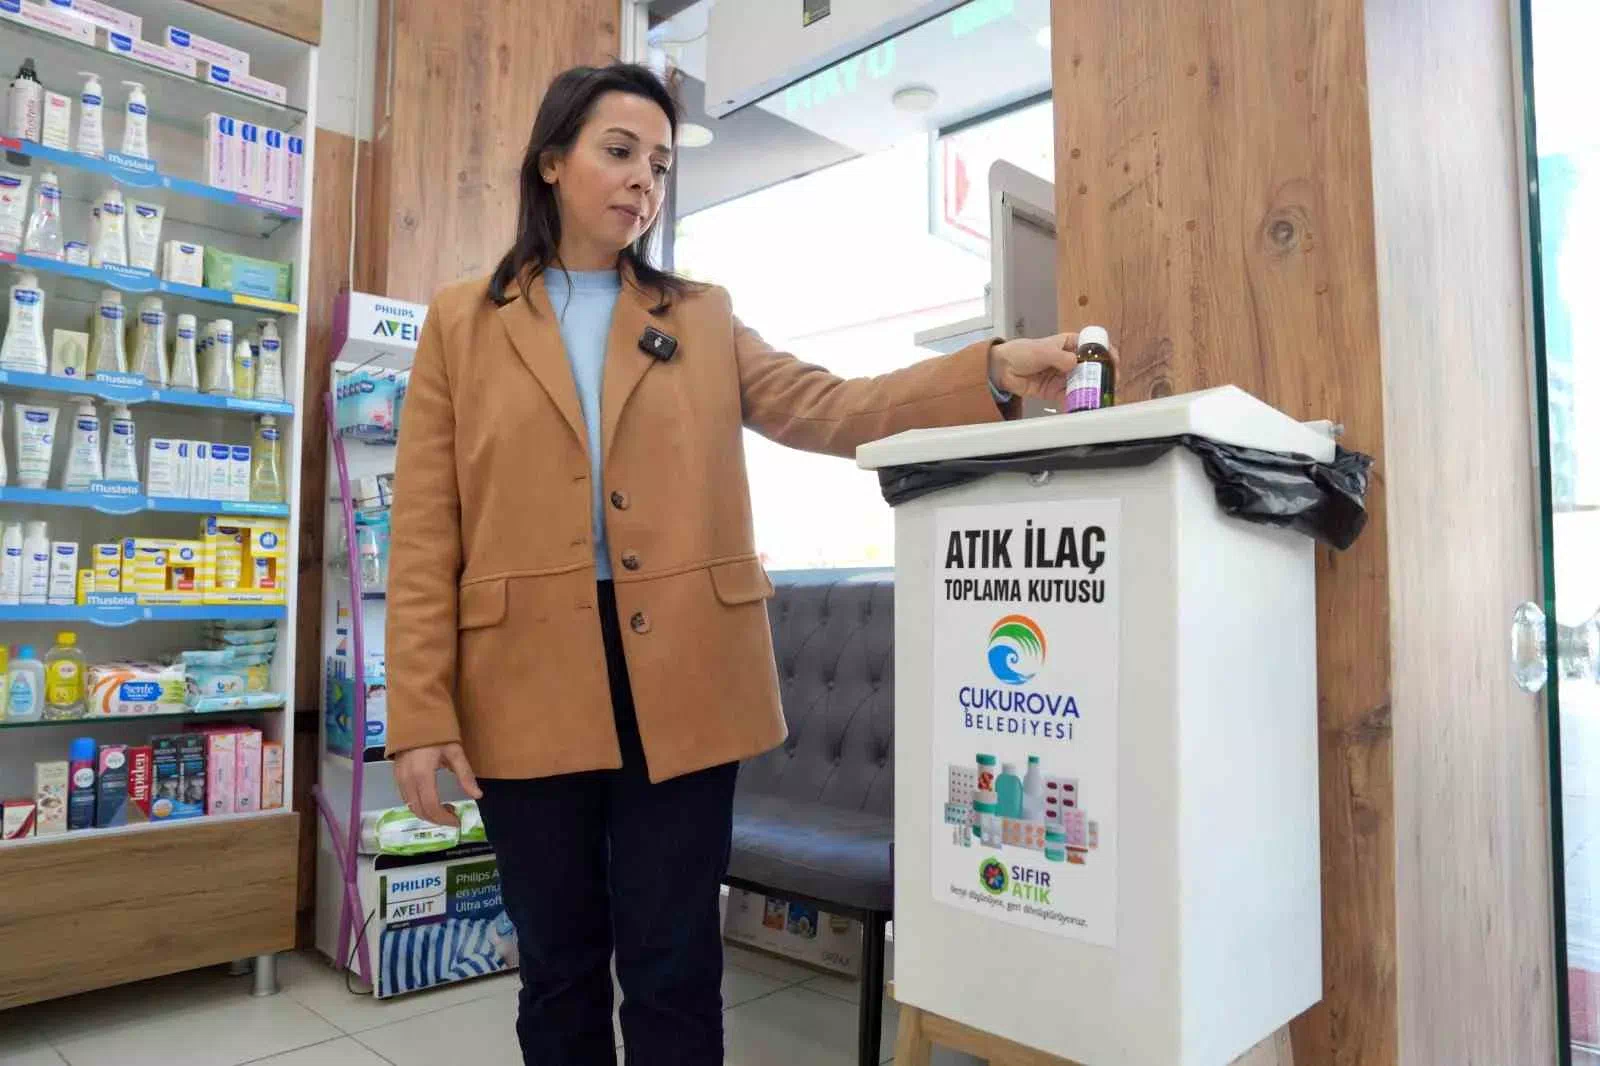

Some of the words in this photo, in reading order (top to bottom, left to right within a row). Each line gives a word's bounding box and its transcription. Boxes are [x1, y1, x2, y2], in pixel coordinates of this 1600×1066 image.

[375, 304, 414, 318] PHILIPS
[945, 529, 1013, 569] ATIK
[1024, 519, 1106, 574] İLAÇ
[944, 579, 1022, 601] TOPLAMA
[1028, 580, 1105, 603] KUTUSU
[959, 686, 1081, 718] ÇUKUROVA
[965, 713, 1073, 740] BELEDİYESİ
[392, 876, 441, 893] PHILIPS
[456, 871, 490, 884] Philips
[1011, 865, 1051, 888] SIFIR
[1012, 882, 1051, 905] ATIK
